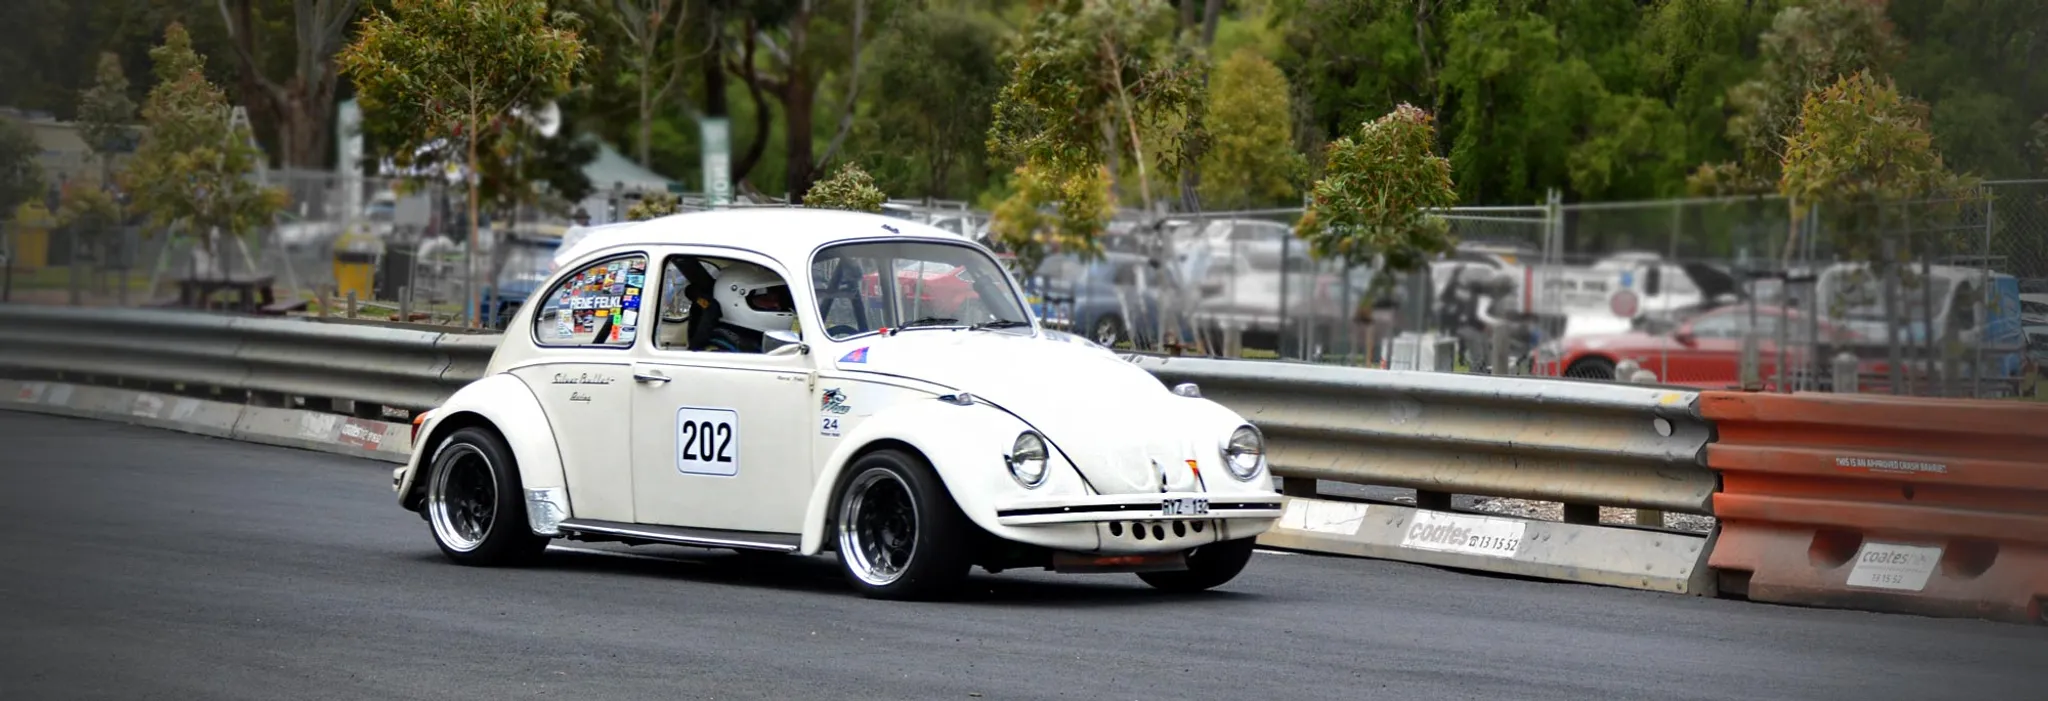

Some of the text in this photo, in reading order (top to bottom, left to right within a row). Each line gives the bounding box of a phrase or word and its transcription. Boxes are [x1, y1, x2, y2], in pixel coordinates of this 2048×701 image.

[823, 418, 838, 430] 24
[682, 420, 732, 462] 202
[1850, 458, 1856, 467] IS
[1857, 459, 1866, 468] AN
[1867, 459, 1899, 469] APPROVED
[1899, 461, 1920, 471] CRASH
[1409, 522, 1518, 552] coates 13 15 52
[1862, 551, 1909, 565] coates
